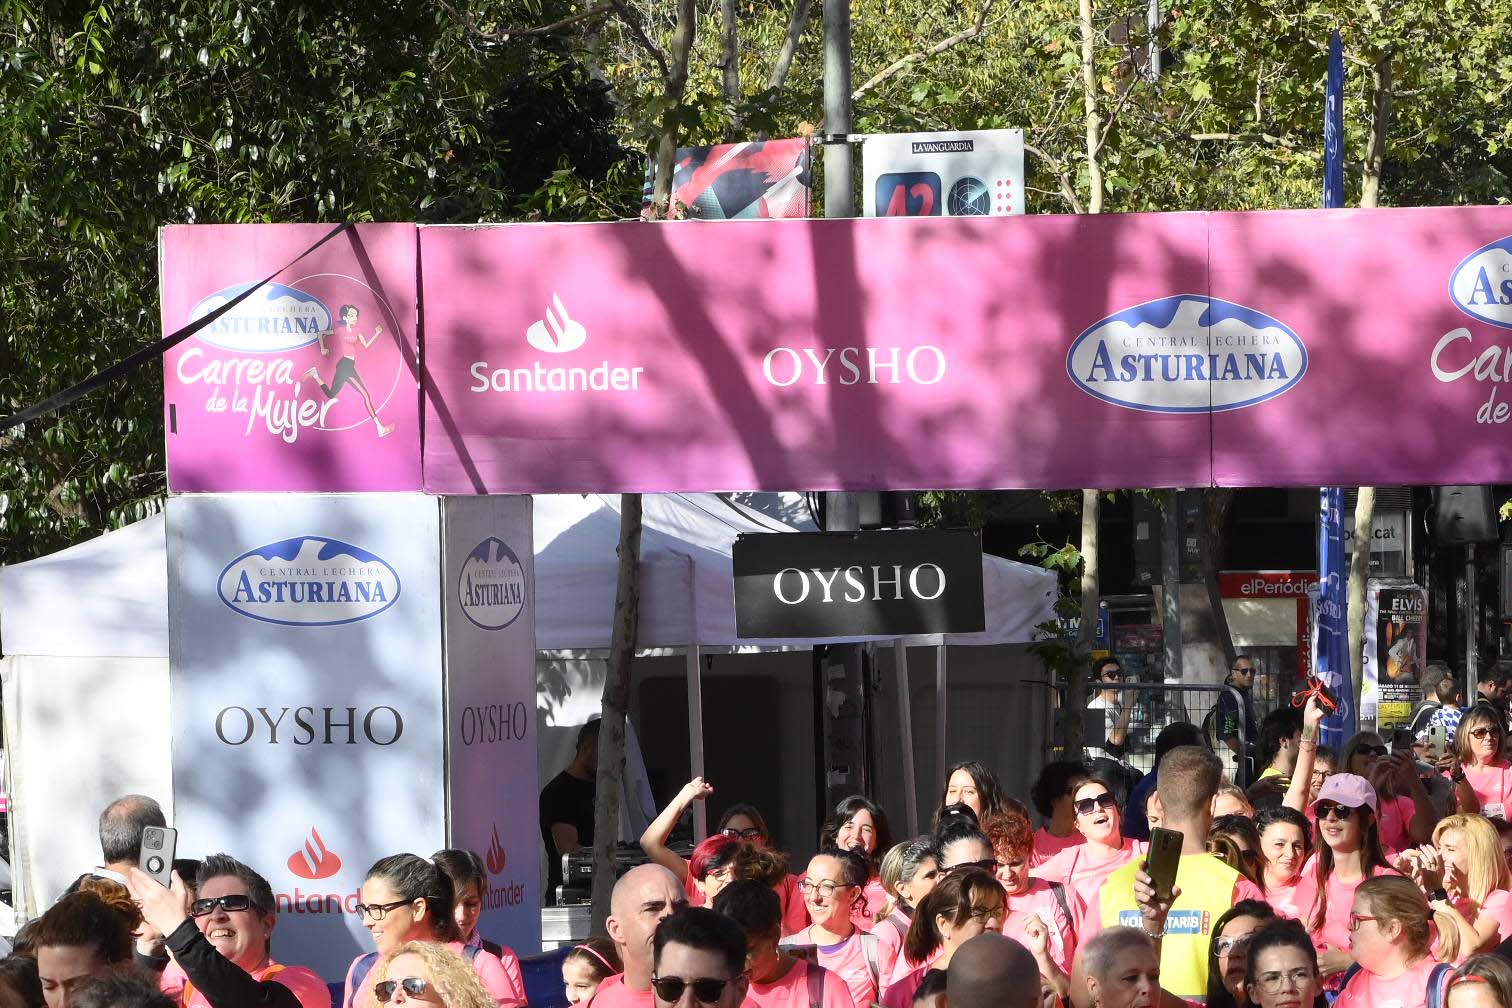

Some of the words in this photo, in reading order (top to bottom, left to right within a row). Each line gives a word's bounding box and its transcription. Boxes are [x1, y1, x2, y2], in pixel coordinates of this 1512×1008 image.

[1122, 334, 1199, 347] CENTRAL
[1205, 334, 1281, 347] LECHERA
[176, 348, 296, 385] Carrera
[470, 359, 644, 393] Santander
[762, 345, 946, 387] OYSHO
[1085, 340, 1289, 384] ASTURIANA
[205, 386, 227, 413] de
[231, 385, 248, 413] la
[245, 380, 339, 444] Mujer
[1476, 386, 1510, 425] de
[232, 570, 388, 603] ASTURIANA
[463, 573, 522, 607] ASTURIANA
[773, 561, 946, 605] OYSHO
[1391, 598, 1422, 611] ELVIS
[215, 705, 404, 747] OYSHO
[461, 701, 527, 747] OYSHO
[482, 880, 525, 913] ntander
